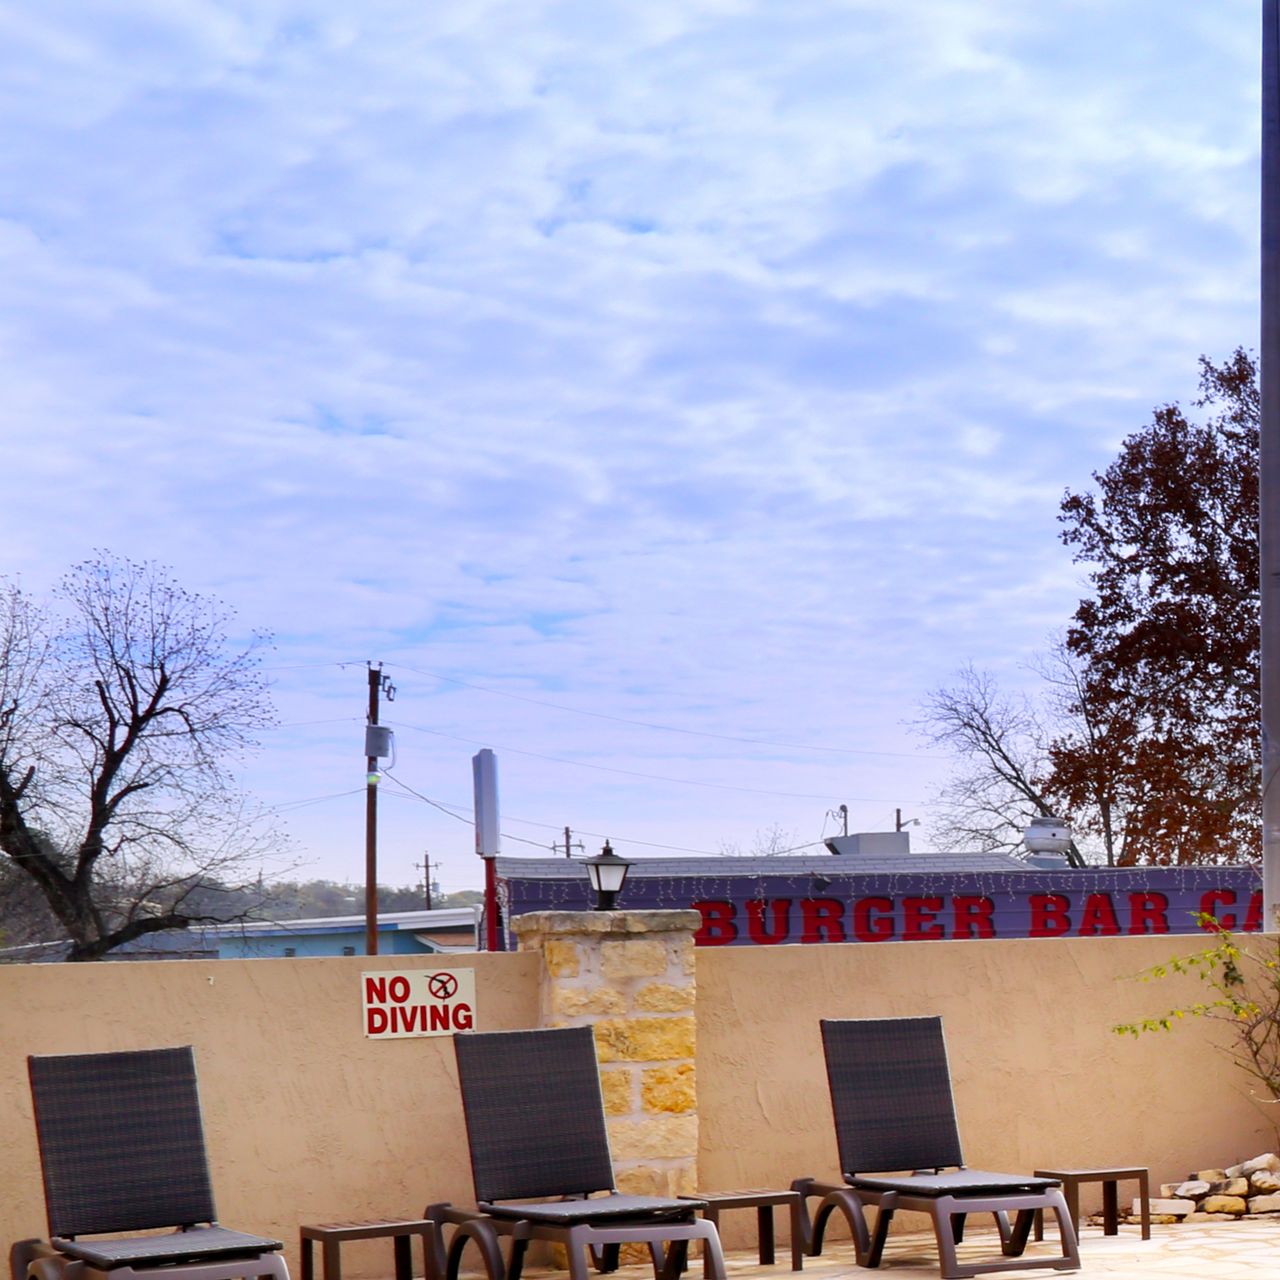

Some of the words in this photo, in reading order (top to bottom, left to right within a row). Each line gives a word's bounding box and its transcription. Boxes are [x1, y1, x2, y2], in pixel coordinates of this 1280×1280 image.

[692, 896, 998, 946] BURGER
[1028, 891, 1170, 937] BAR
[365, 975, 411, 1004] NO
[367, 1003, 473, 1035] DIVING
